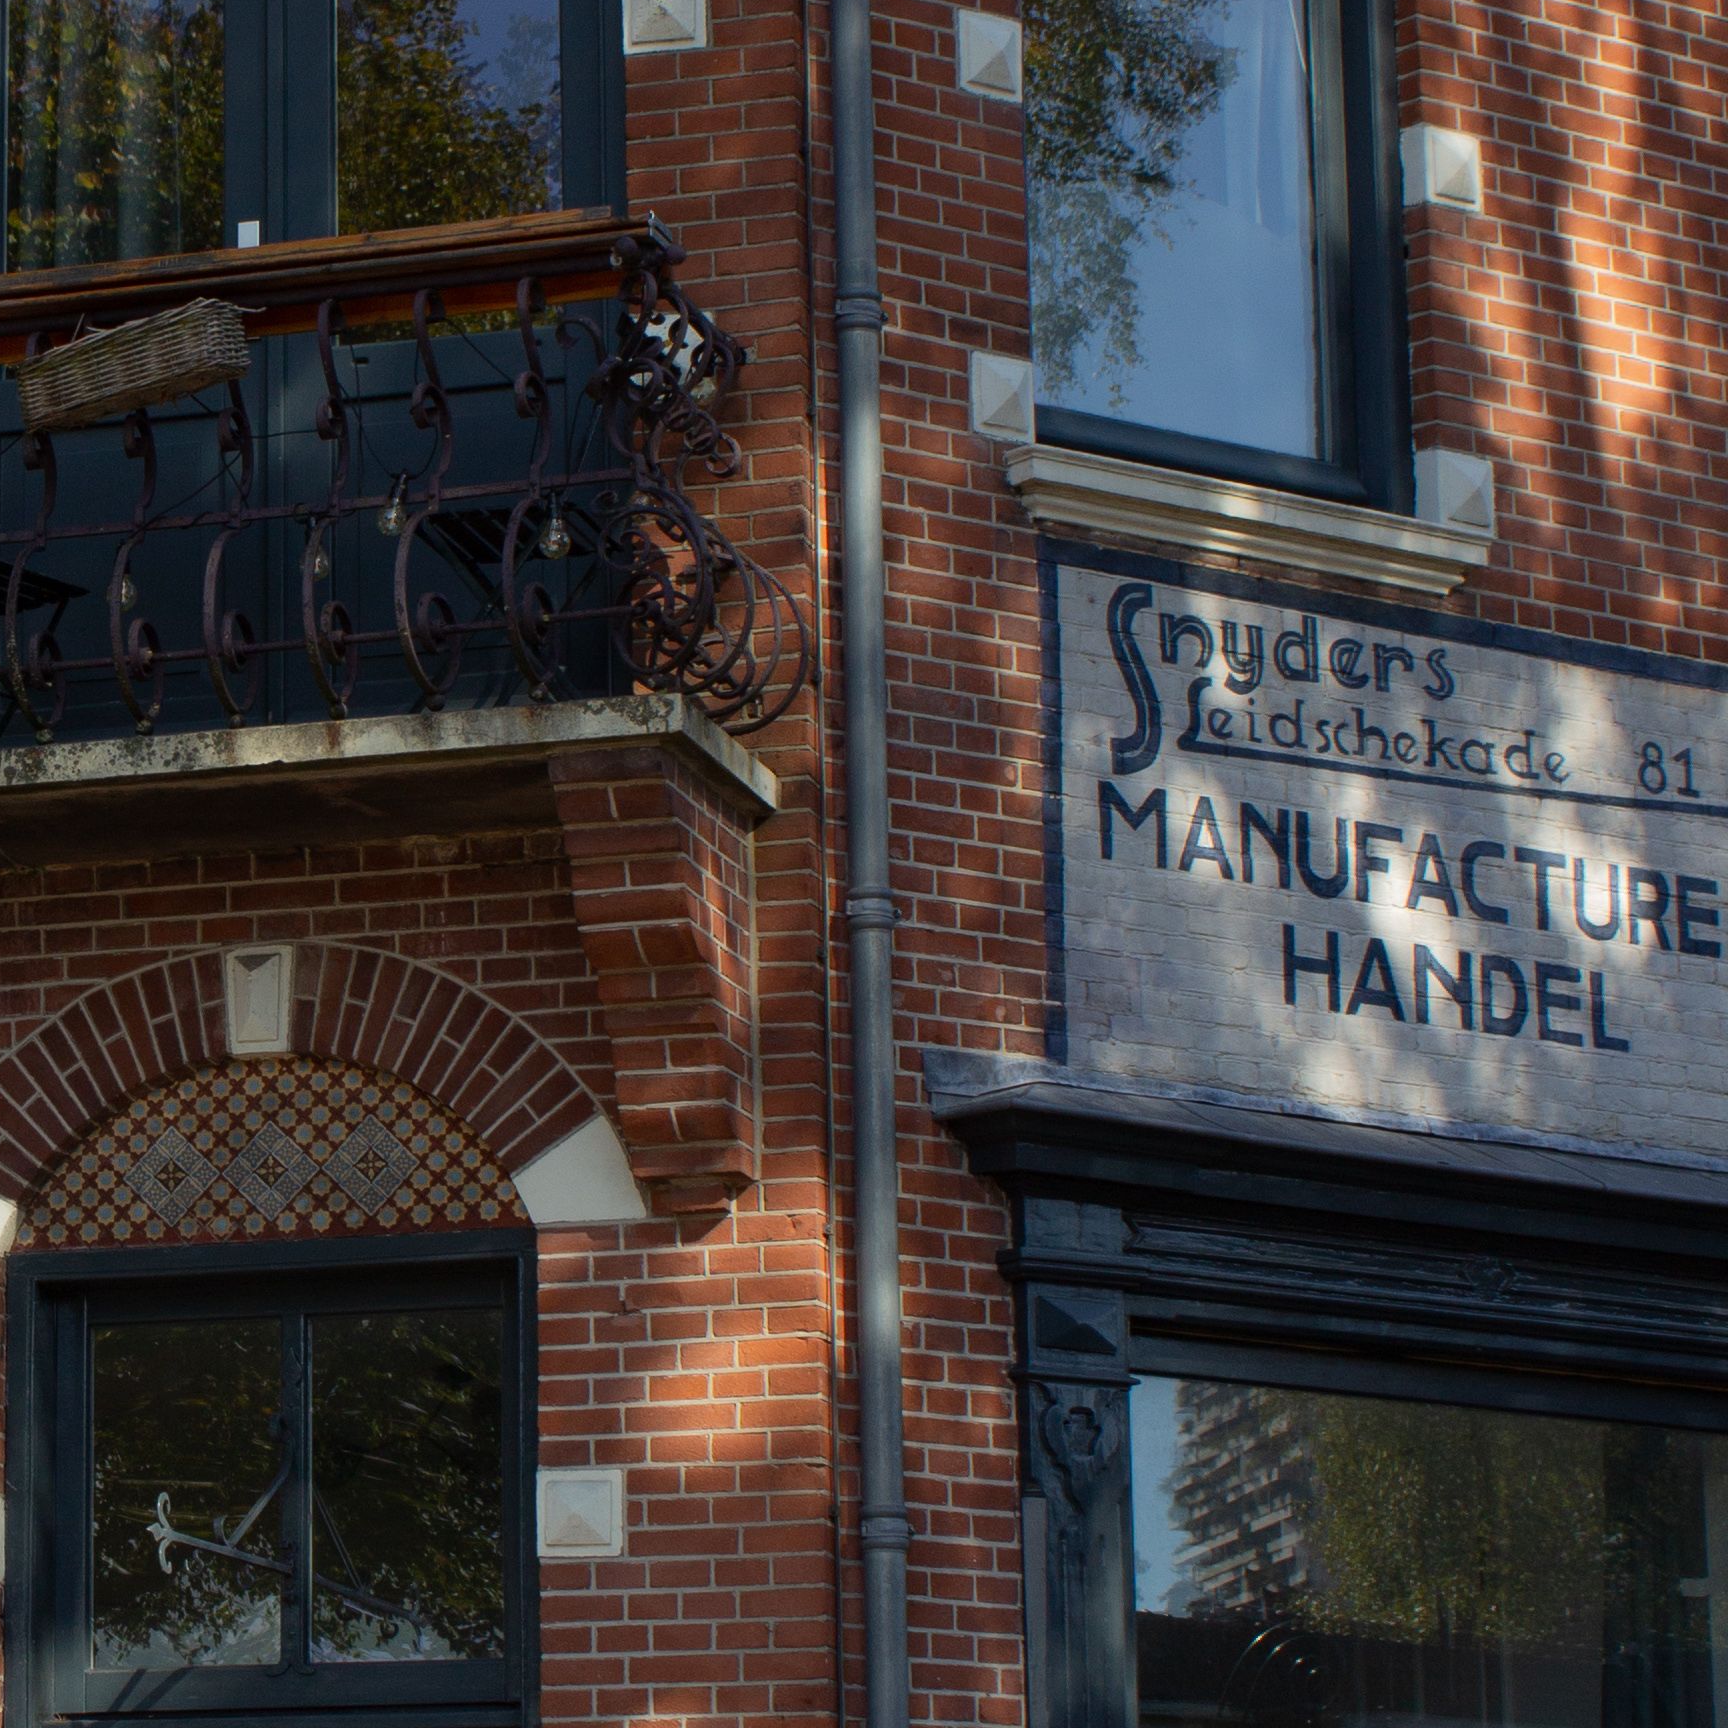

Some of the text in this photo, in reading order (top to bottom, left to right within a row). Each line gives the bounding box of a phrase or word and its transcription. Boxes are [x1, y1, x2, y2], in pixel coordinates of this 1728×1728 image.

[1106, 582, 1455, 775] Snyders
[1177, 677, 1701, 798] Leidschekade 81
[1098, 779, 1722, 959] MANUFACTURE
[1282, 924, 1630, 1053] HANDEL
